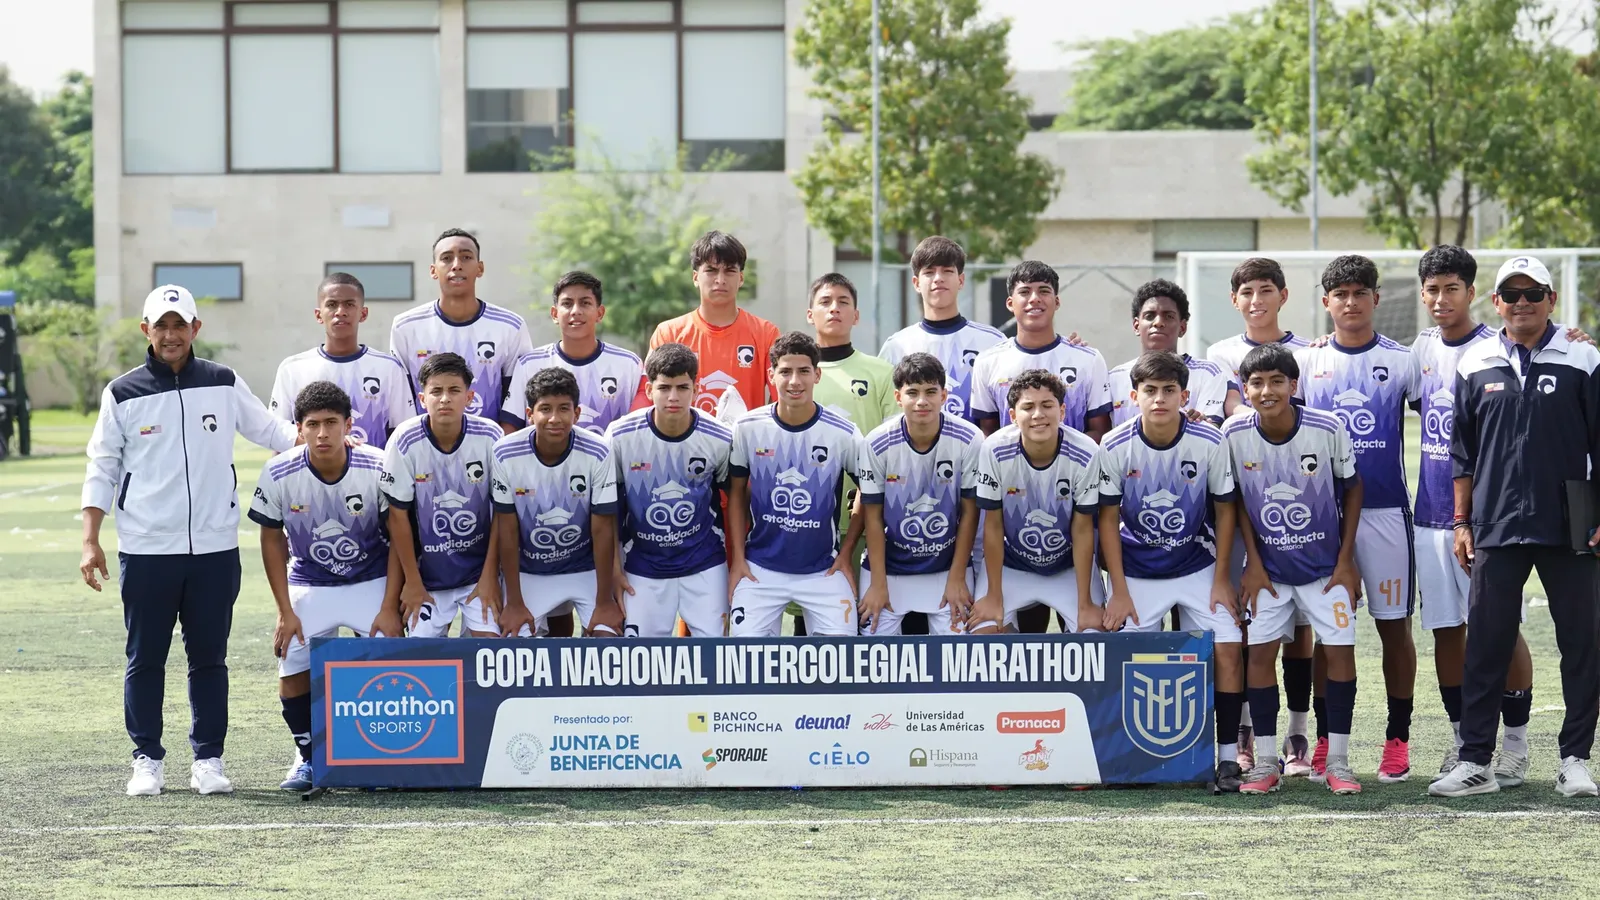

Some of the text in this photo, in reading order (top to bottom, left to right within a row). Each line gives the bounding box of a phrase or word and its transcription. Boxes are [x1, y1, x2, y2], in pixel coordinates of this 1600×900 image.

[637, 523, 701, 542] autodidacta
[523, 538, 590, 560] autodidacta
[659, 539, 684, 548] editorial
[1379, 578, 1401, 606] 41
[1333, 602, 1349, 628] 6
[475, 642, 1105, 688] COPA NACIONAL INTERCOLEGIAL MARATHON
[335, 696, 455, 717] marathon
[554, 715, 633, 725] Presentado por:
[714, 712, 757, 721] BANCO
[795, 714, 851, 730] deuna!
[906, 711, 964, 720] Universidad
[1002, 717, 1060, 729] Pronaca
[370, 721, 422, 734] SPORTS
[714, 723, 783, 732] PICHINCHA
[906, 722, 985, 732] de Las Américas
[549, 734, 639, 752] JUNTA DE
[550, 754, 682, 771] BENEFICENCIA
[716, 748, 768, 762] SPORADE
[930, 749, 978, 762] Hispana
[1018, 749, 1054, 765] PONY
